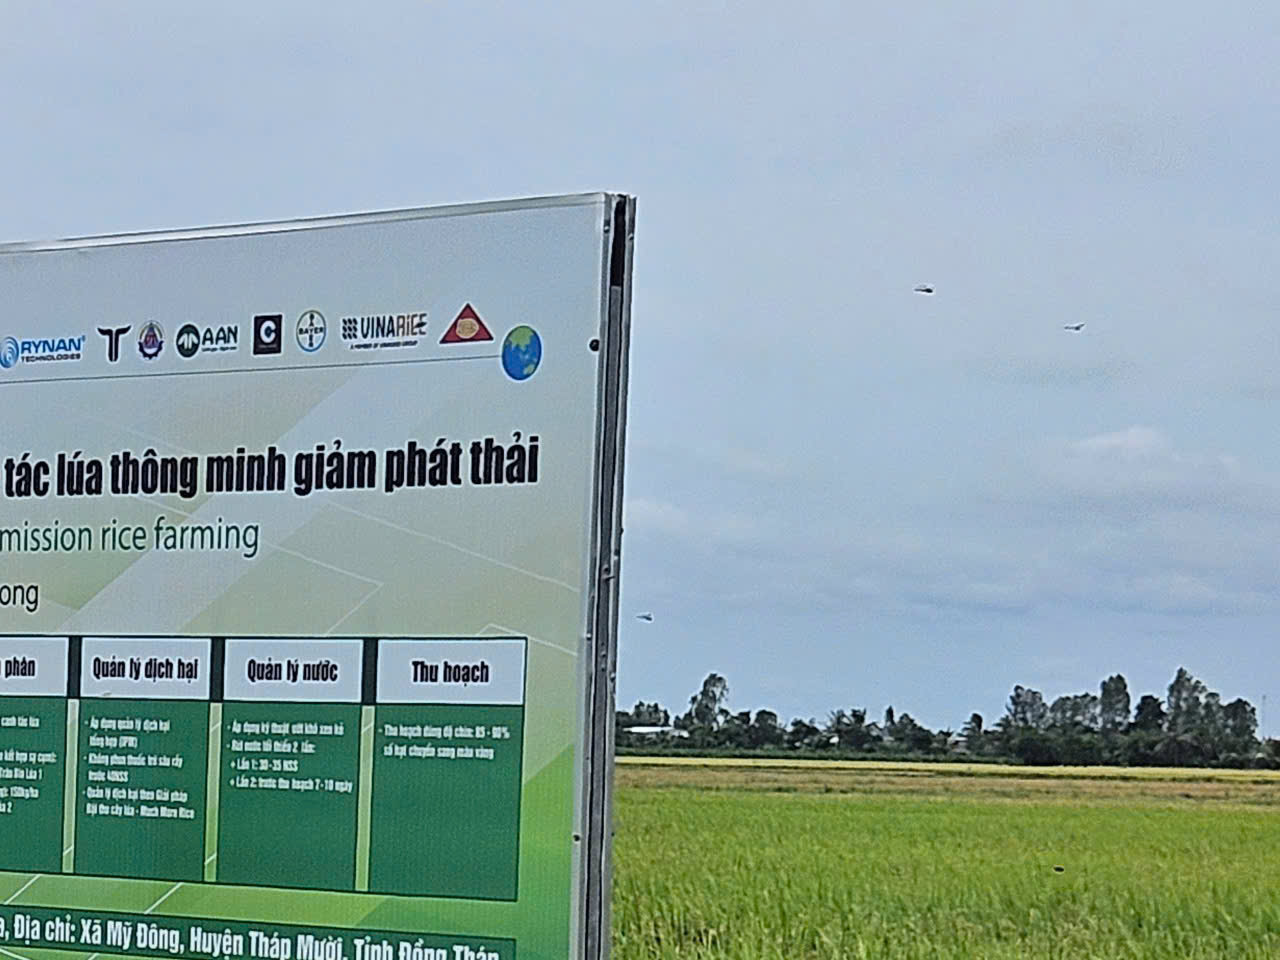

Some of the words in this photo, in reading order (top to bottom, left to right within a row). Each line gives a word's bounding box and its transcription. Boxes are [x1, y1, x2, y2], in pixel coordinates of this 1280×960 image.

[298, 326, 324, 335] BAYER
[21, 353, 81, 363] TECHNOLOGIES
[4, 452, 50, 497] tác
[56, 451, 103, 497] lúa
[110, 448, 199, 499] thông
[205, 447, 286, 493] minh
[293, 439, 377, 496] giảm
[384, 438, 463, 493] phát
[470, 431, 539, 485] thải
[101, 519, 147, 551] rice
[154, 516, 259, 558] farming
[4, 656, 35, 679] phân
[93, 655, 125, 679] Quản
[129, 657, 141, 680] lý
[144, 658, 173, 682] dịch
[178, 658, 198, 684] hại
[248, 657, 282, 683] Quản
[287, 658, 299, 683] lý
[303, 659, 338, 682] nước
[412, 661, 438, 683] Thu
[443, 660, 489, 687] hoạch
[14, 914, 41, 945] Địa
[45, 914, 76, 943] chỉ:
[80, 918, 102, 945] Xã
[107, 918, 133, 950] Mỹ
[136, 921, 185, 954] Đông,
[190, 926, 244, 960] Huyện
